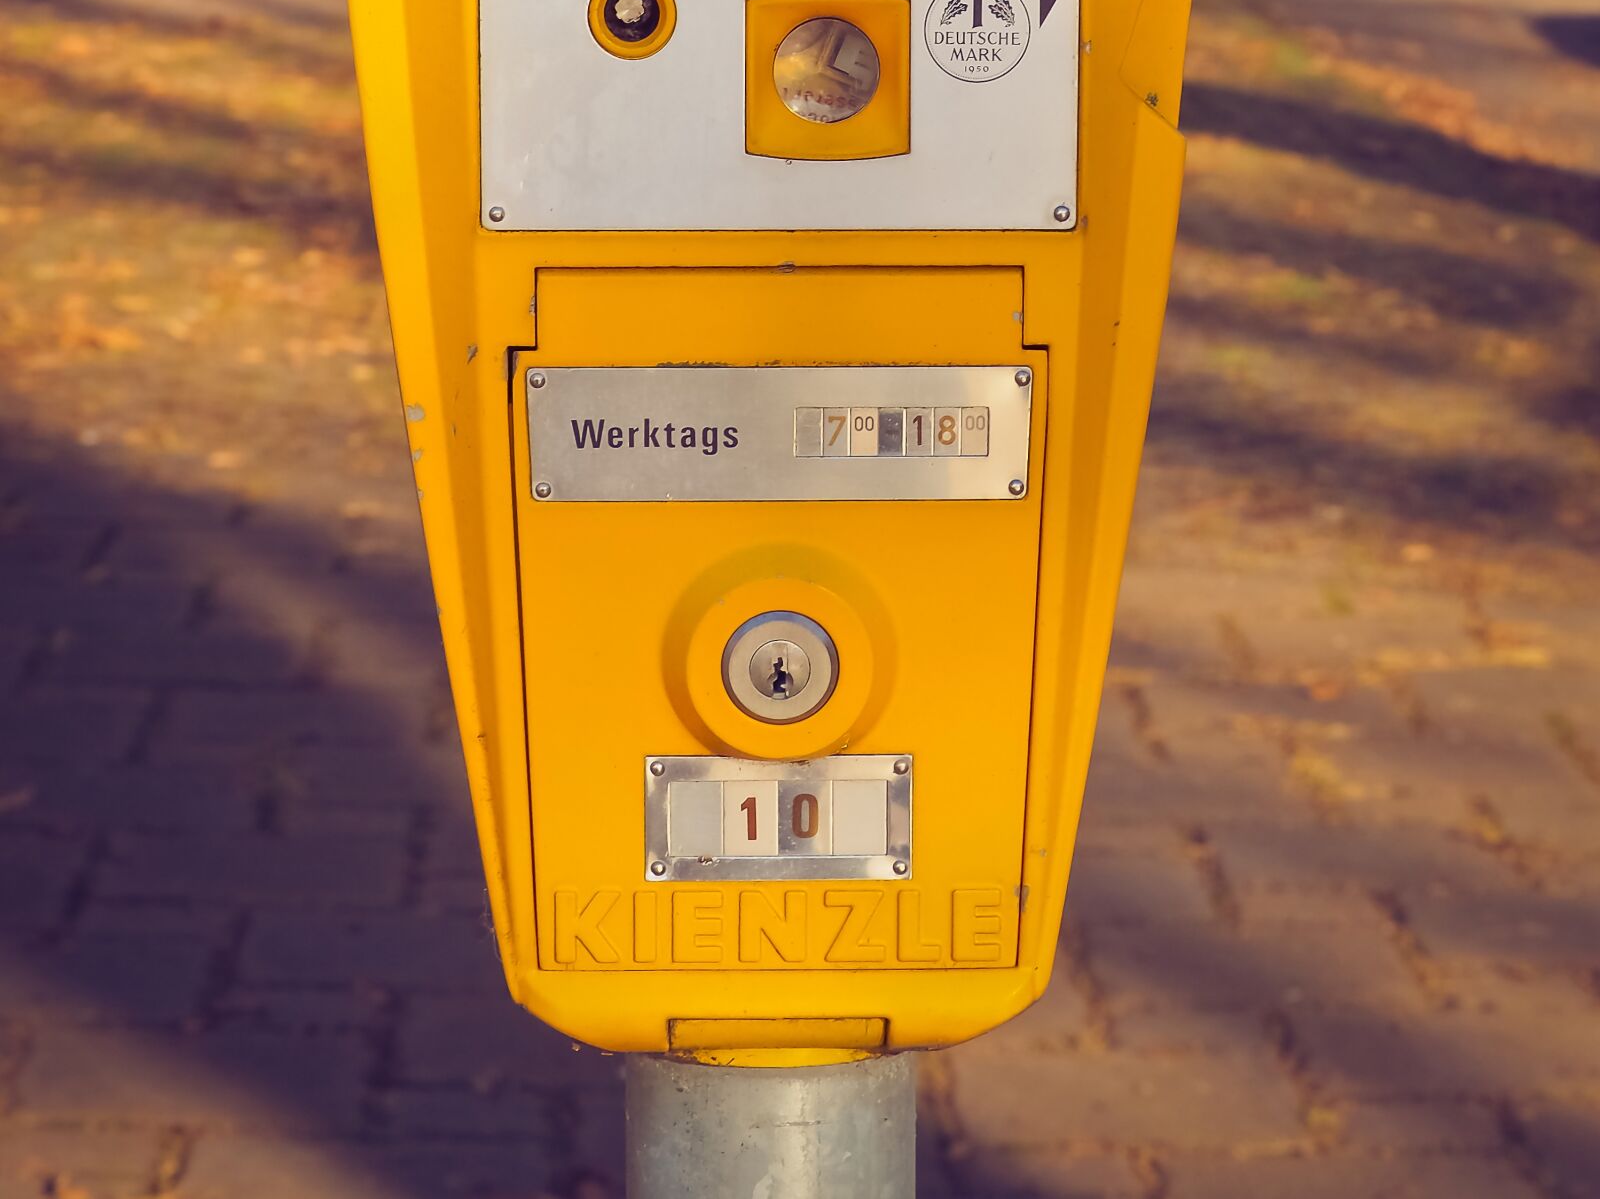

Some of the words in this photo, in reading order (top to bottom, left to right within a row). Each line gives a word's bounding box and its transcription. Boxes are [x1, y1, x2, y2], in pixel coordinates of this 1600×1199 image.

[934, 31, 1021, 46] DEUTSCHE
[950, 47, 1003, 62] MARK
[964, 65, 990, 73] 1950
[570, 418, 740, 456] Werktags
[553, 887, 1002, 964] KIENZLE
